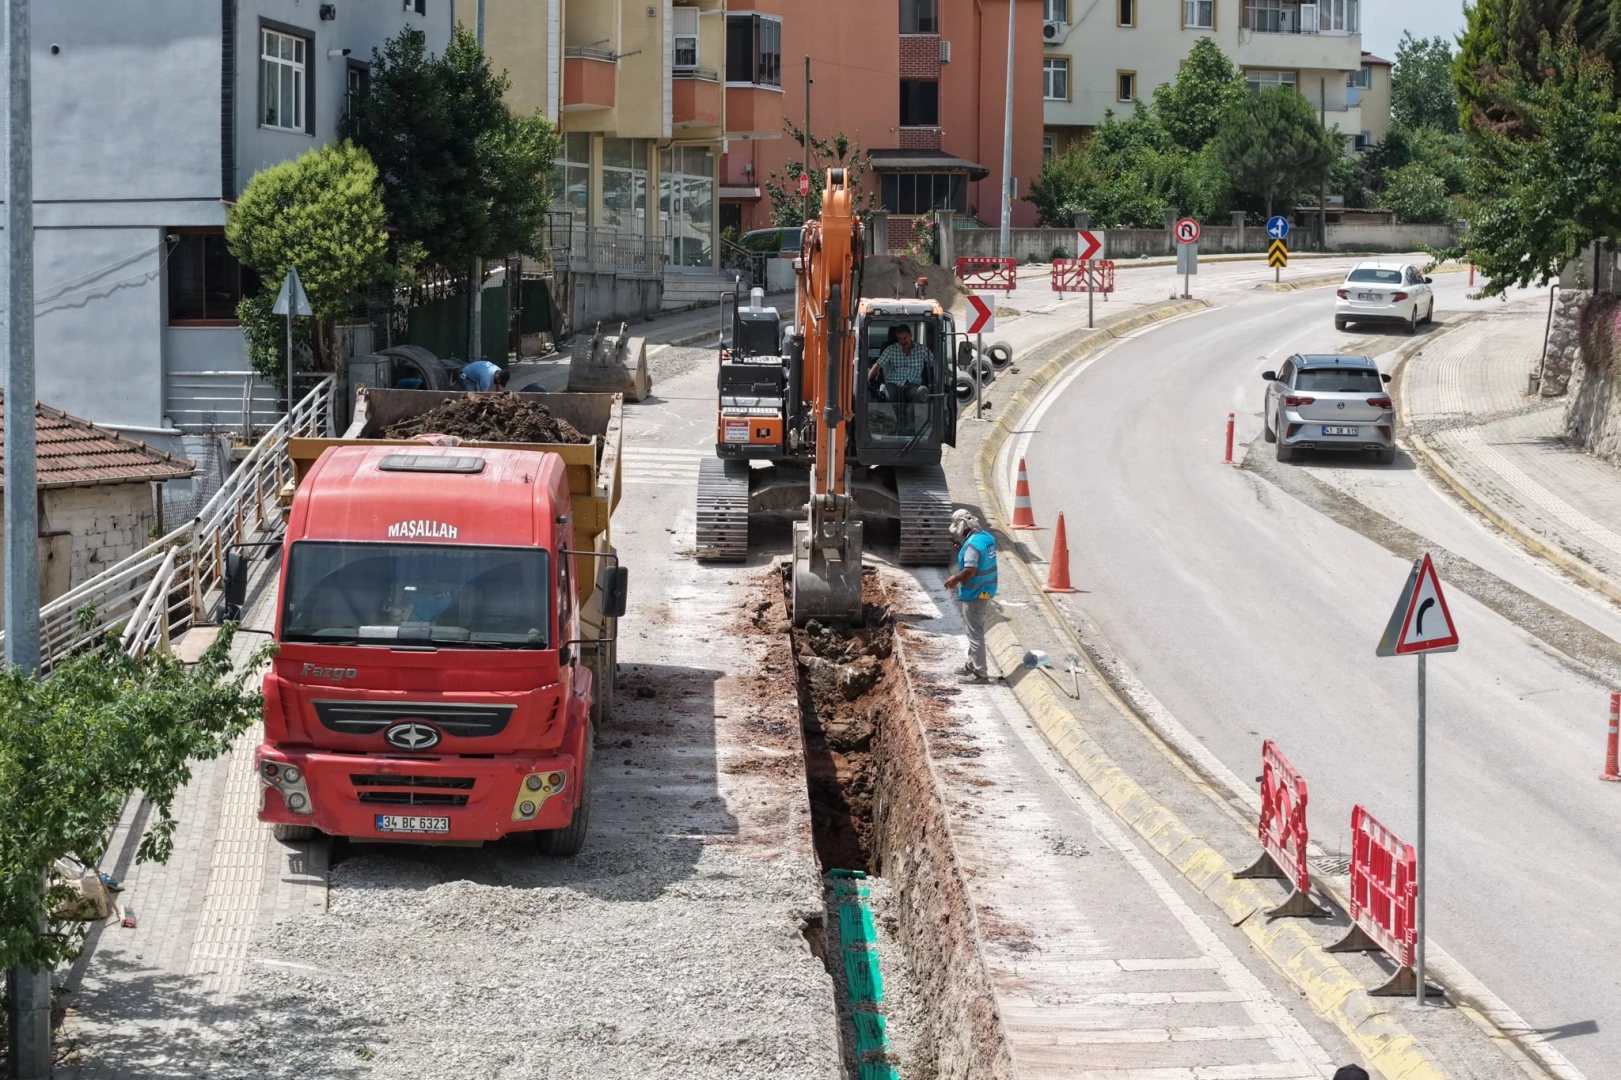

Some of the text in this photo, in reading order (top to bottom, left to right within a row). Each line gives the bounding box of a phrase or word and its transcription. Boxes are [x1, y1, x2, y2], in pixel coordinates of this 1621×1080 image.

[388, 519, 458, 539] MAŞALLAH
[301, 662, 357, 681] Fargo
[384, 816, 398, 828] 34
[402, 817, 416, 829] BC
[419, 818, 447, 830] 6323
